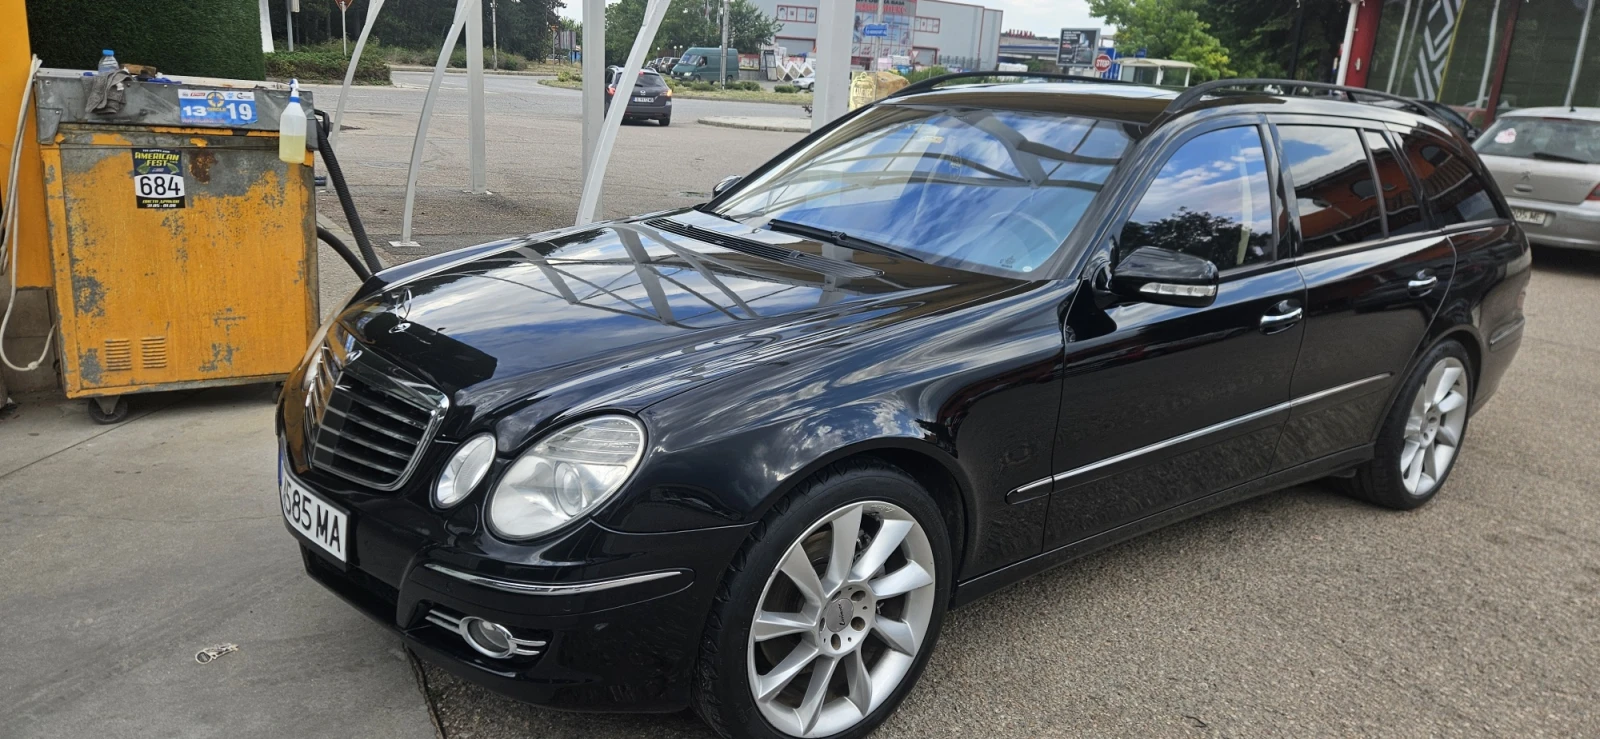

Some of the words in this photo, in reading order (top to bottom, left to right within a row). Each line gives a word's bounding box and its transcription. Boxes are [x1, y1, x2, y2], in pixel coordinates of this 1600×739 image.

[1096, 59, 1110, 68] STOP
[183, 105, 207, 116] 13
[226, 103, 252, 120] 19
[135, 152, 179, 160] AMERICAN
[140, 176, 181, 195] 684
[316, 504, 341, 552] MA
